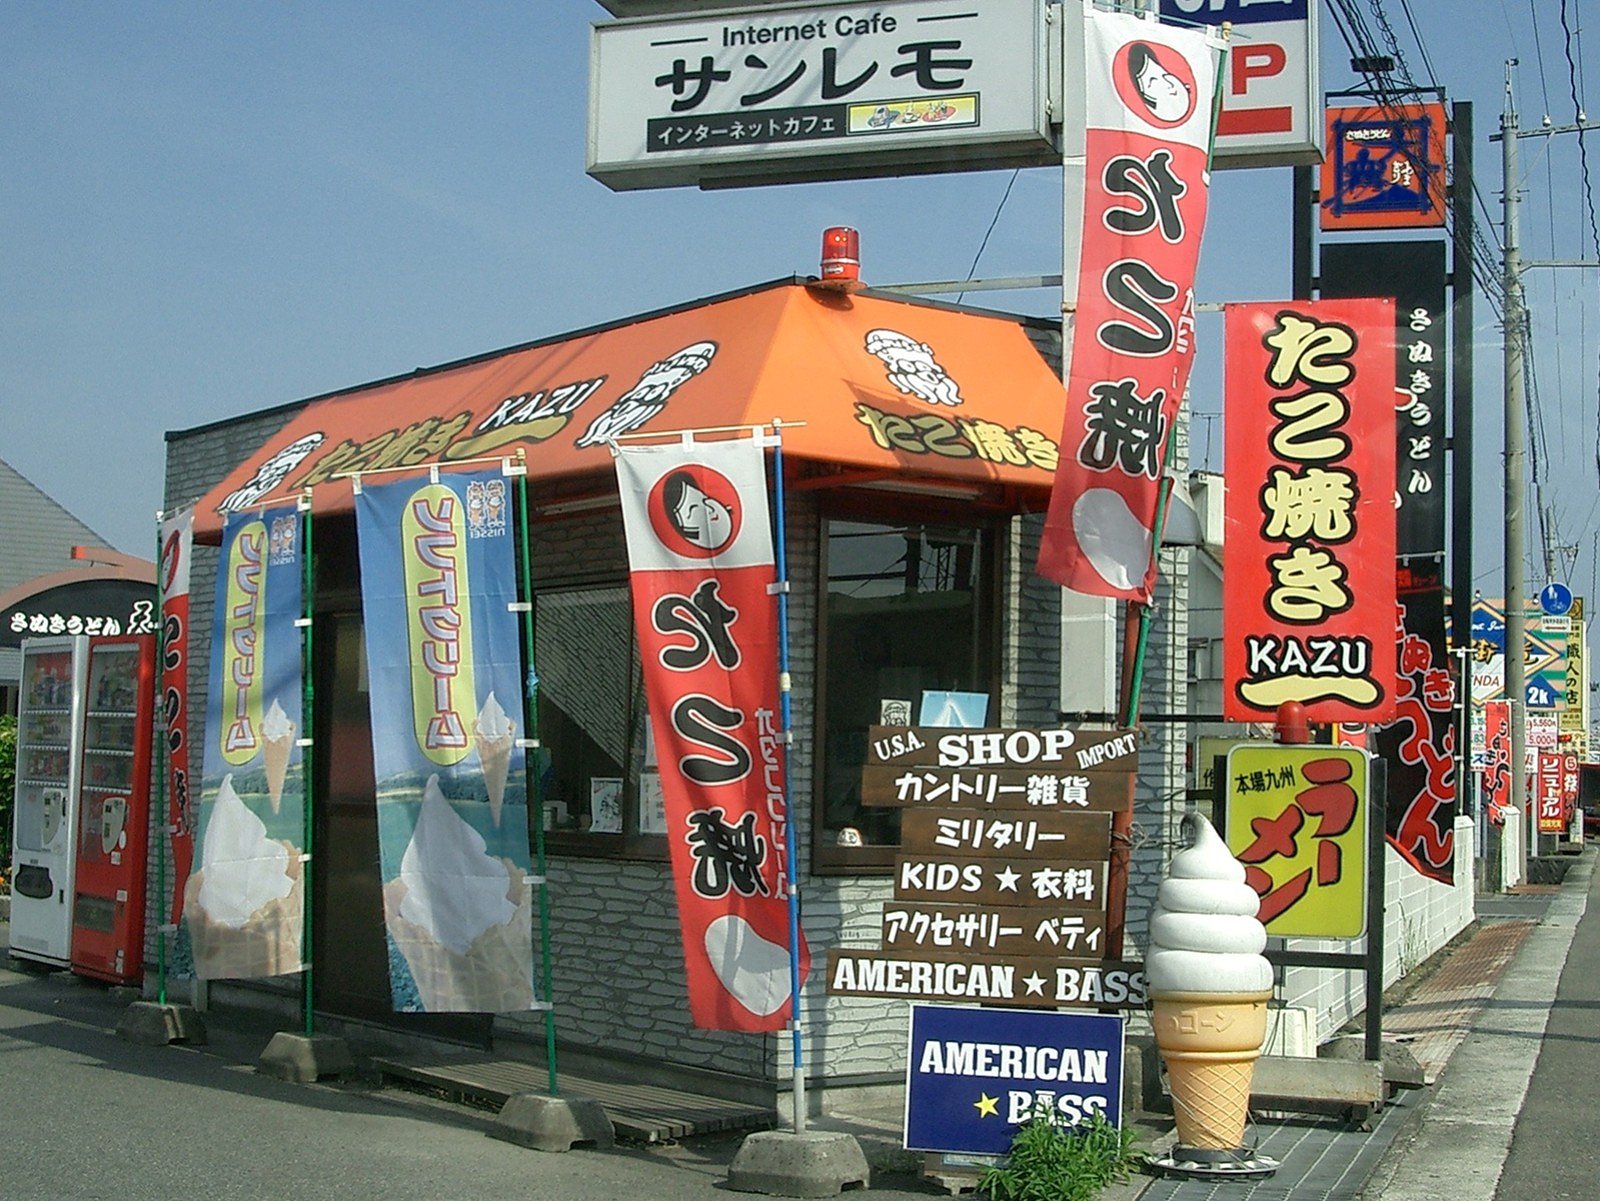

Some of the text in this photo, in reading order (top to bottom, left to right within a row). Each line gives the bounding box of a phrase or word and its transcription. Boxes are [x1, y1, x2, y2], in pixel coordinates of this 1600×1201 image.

[722, 13, 897, 47] Internet Cafe
[655, 39, 973, 112] サンレモ
[657, 117, 837, 145] インターネットカフェ
[479, 376, 608, 431] KAZU
[1407, 307, 1434, 495] さぬきうどん
[292, 411, 473, 489] たこ焼き
[854, 402, 1061, 471] たこ焼き
[1263, 311, 1359, 624] たこ焼き
[10, 612, 121, 636] さぬきうどん
[1248, 637, 1371, 677] KAZU
[1528, 686, 1549, 705] 2k
[874, 730, 1137, 770] U.S.A. SHOP IMPORT
[895, 772, 1091, 807] カントリー雑貨
[1234, 765, 1295, 796] 本場九州
[935, 818, 1065, 851] ミリタリー
[901, 863, 1095, 901] KIDS 衣料
[884, 911, 1102, 951] アクセサリー ベティ
[833, 957, 1015, 999] AMERICAN
[920, 1040, 1108, 1084] AMERICAN
